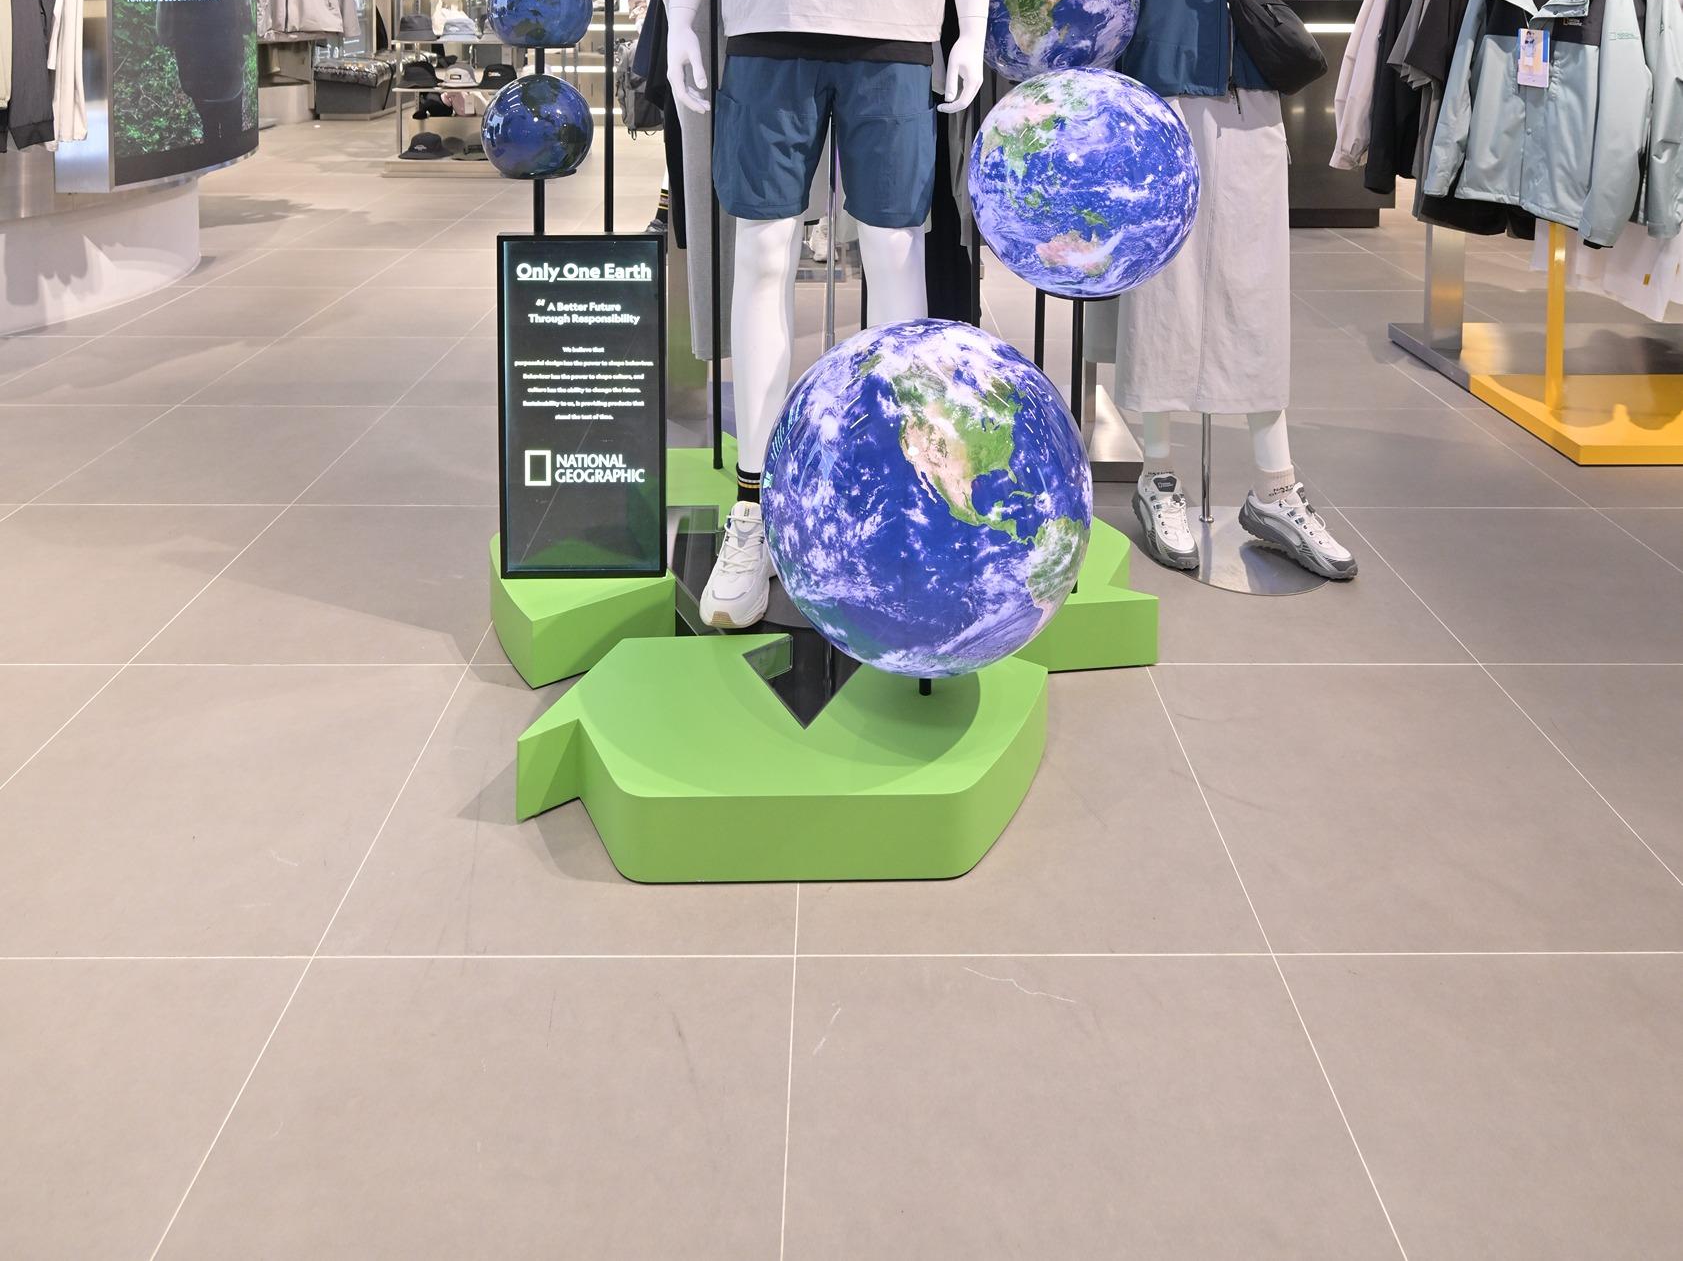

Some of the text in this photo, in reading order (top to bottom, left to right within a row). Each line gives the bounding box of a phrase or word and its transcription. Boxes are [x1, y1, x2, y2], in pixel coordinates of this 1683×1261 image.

[516, 263, 652, 283] Only One Earth
[547, 302, 556, 311] A
[557, 302, 588, 311] Better
[589, 302, 622, 311] Future
[528, 314, 640, 325] Through Responsibility
[556, 454, 627, 468] NATIONAL
[554, 468, 646, 483] GEOGRAPHIC
